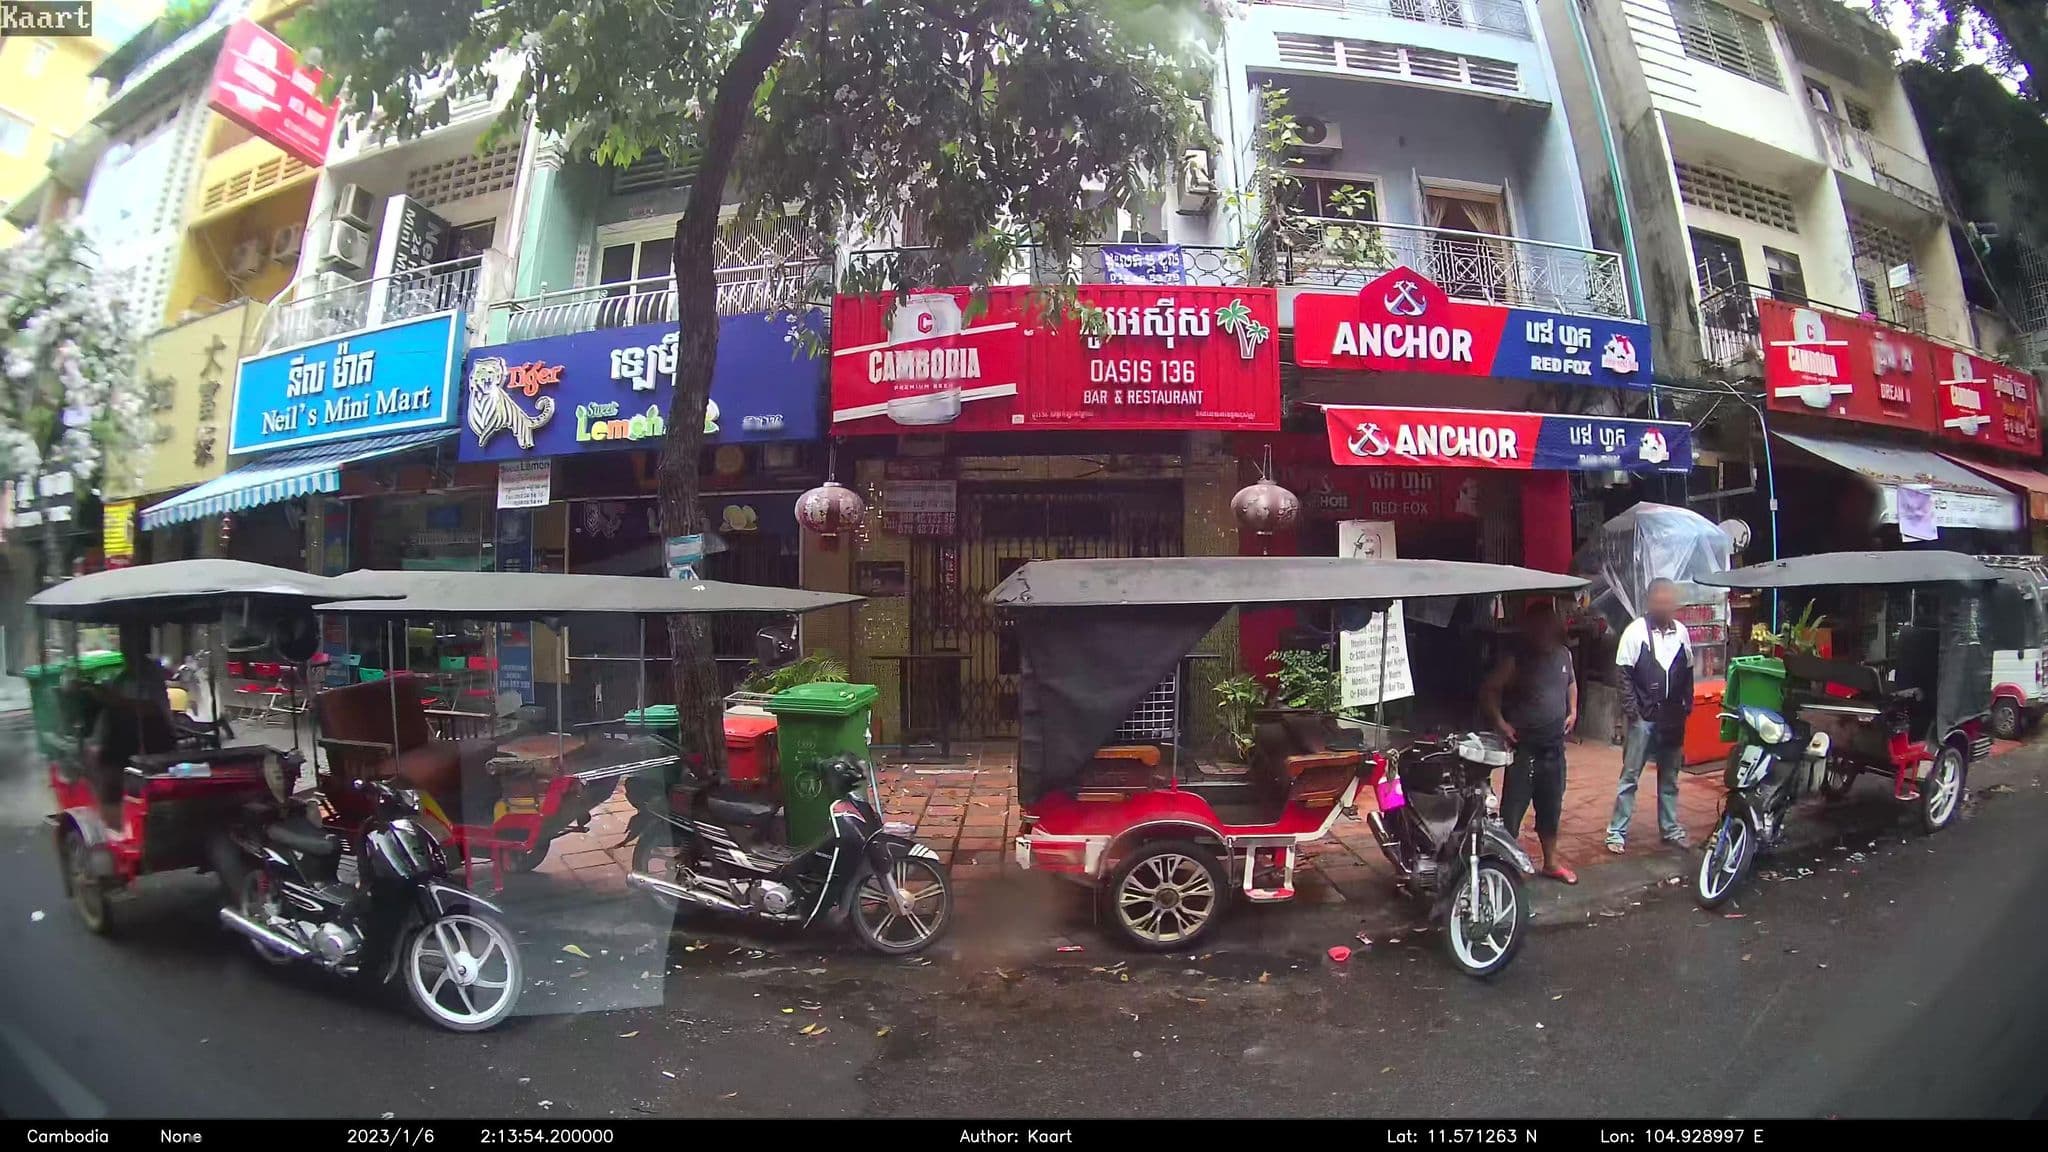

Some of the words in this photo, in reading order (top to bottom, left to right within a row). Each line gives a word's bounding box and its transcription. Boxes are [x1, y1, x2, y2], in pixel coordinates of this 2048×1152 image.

[1331, 321, 1472, 362] ANCHOR
[507, 360, 564, 397] Tiger
[869, 347, 981, 384] CAMBODIA
[1090, 359, 1152, 383] OASIS
[1161, 359, 1195, 383] 136
[1531, 355, 1562, 372] RED
[1563, 359, 1592, 376] FOX
[894, 383, 930, 391] PREMIUM
[1084, 390, 1108, 404] BAR
[1115, 390, 1124, 404] &
[1128, 390, 1203, 404] RESTAURANT
[261, 402, 317, 435] Neil's
[324, 394, 370, 424] Mini
[376, 385, 432, 415] Mart
[576, 404, 664, 442] Lemon
[1395, 424, 1518, 459] ANCHOR
[1373, 502, 1397, 515] RED
[1404, 502, 1428, 515] FOX
